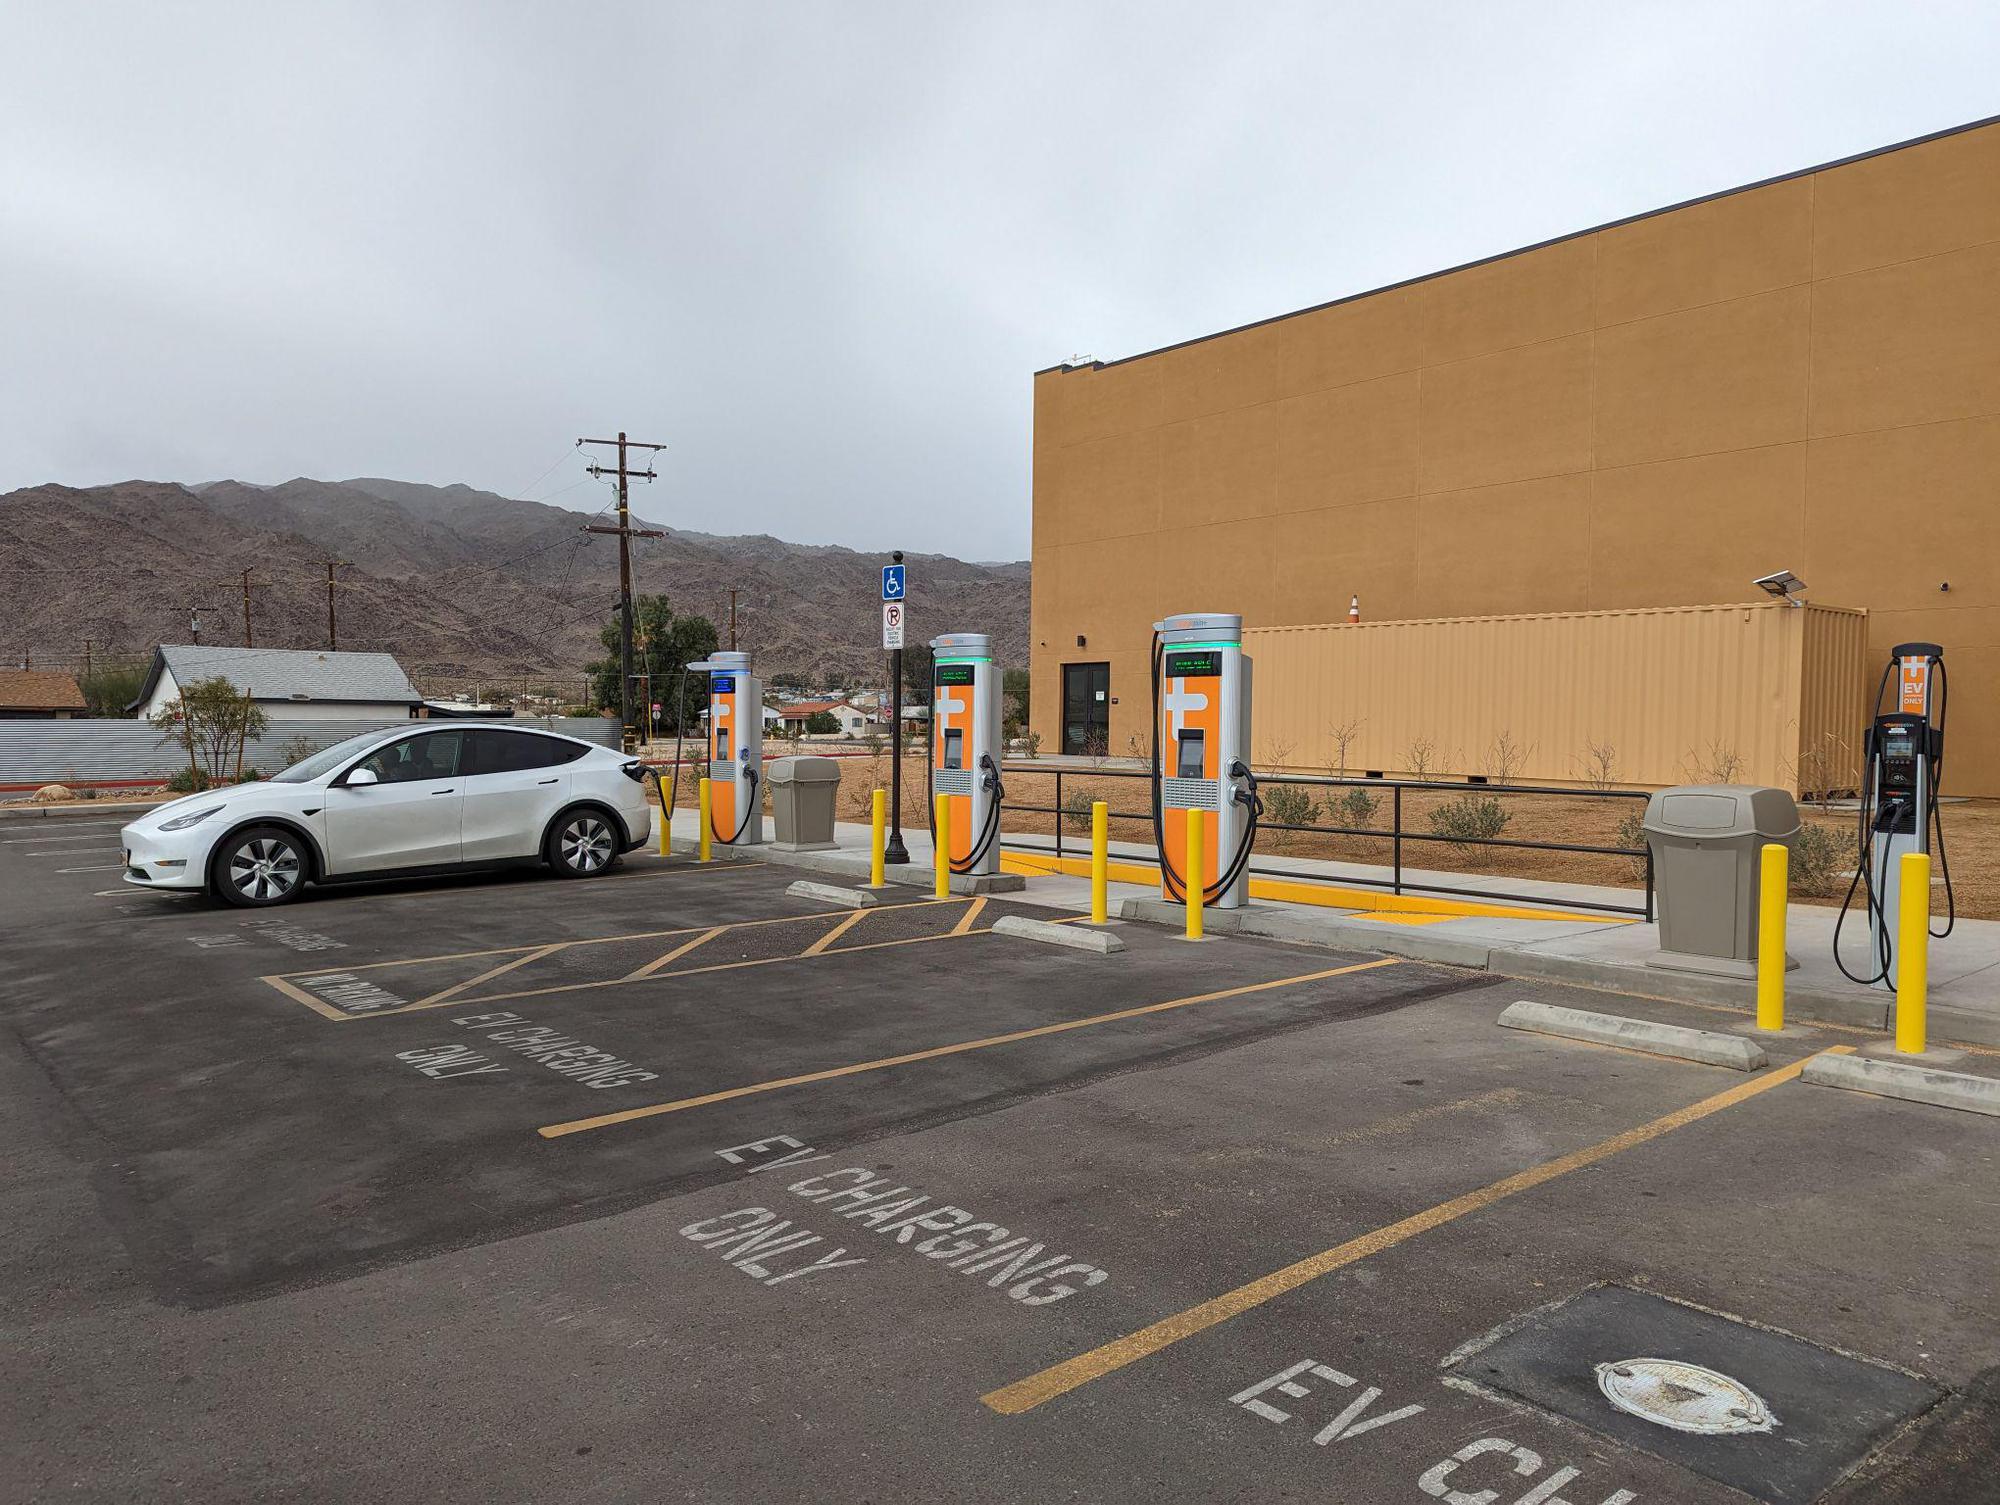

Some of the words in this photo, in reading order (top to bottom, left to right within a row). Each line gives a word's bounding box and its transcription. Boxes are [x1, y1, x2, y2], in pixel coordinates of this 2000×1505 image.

[1903, 697, 1924, 705] ONLY
[1904, 682, 1924, 694] EV
[450, 1011, 532, 1030] EV
[395, 1044, 511, 1081] ONLY
[487, 1026, 660, 1090] CHARGING
[714, 1134, 833, 1175] EV
[787, 1166, 1109, 1306] CHARGING
[678, 1206, 868, 1287] ONLY
[1228, 1358, 1428, 1446] EV
